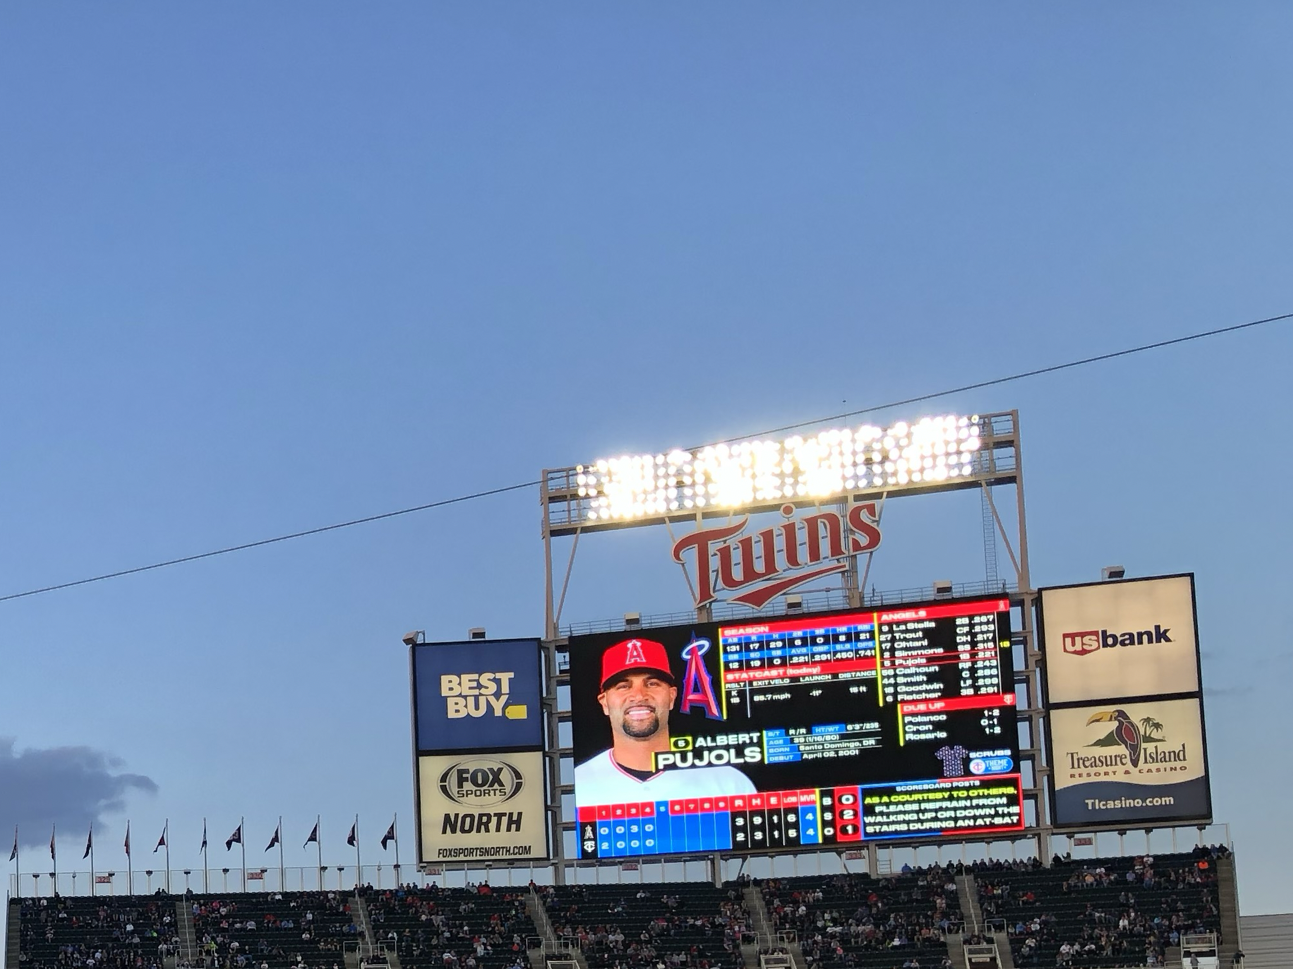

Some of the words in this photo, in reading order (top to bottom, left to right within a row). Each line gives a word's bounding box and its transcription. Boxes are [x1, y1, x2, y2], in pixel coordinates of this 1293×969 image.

[672, 502, 882, 609] Twins
[881, 610, 926, 621] ANGELS
[724, 626, 769, 636] SEASON
[892, 623, 906, 631] La
[907, 621, 936, 630] Stella
[894, 631, 923, 640] Trout
[894, 639, 928, 649] Ohtani
[895, 647, 944, 658] Simmons
[895, 657, 927, 667] Pujols
[726, 669, 785, 680] STATCAST
[787, 666, 821, 676] (today)
[896, 665, 939, 675] Calhoun
[440, 672, 514, 696] BEST
[896, 674, 926, 684] Smith
[897, 682, 943, 692] Goodwin
[897, 691, 942, 701] Fletcher
[447, 695, 509, 718] BUY
[903, 703, 926, 712] DUE
[929, 702, 945, 710] UP
[904, 715, 947, 723] Polanco
[695, 733, 760, 747] ALBERT
[905, 732, 947, 740] Rosario
[657, 747, 762, 769] PUJOLS
[969, 749, 1011, 758] SCRUBS
[1066, 752, 1127, 769] Treasure
[1142, 743, 1187, 764] Island
[457, 767, 505, 789] FOX
[1070, 770, 1117, 779] RESORT
[1138, 766, 1188, 774] CASINO
[895, 782, 951, 792] SCOREBOARD
[952, 780, 980, 788] POSTS
[457, 788, 507, 798] SPORTS
[864, 796, 880, 804] AS
[883, 795, 890, 803] A
[891, 792, 950, 802] COURTESY
[952, 790, 967, 798] TO
[969, 787, 1017, 797] OTHERS,
[875, 804, 919, 813] PLEASE
[921, 801, 970, 811] REFRAIN
[972, 797, 1007, 807] FROM
[864, 813, 918, 823] WALKING
[919, 812, 936, 820] UP
[937, 810, 954, 819] OR
[956, 808, 995, 817] DOWN
[996, 806, 1020, 814] THE
[441, 812, 523, 834] NORTH
[866, 823, 908, 833] STAIRS
[909, 821, 954, 831] DURING
[956, 819, 974, 827] AN
[975, 816, 1019, 826] AT-BAT
[437, 846, 531, 858] FOXSPORTSNORTH.COM
